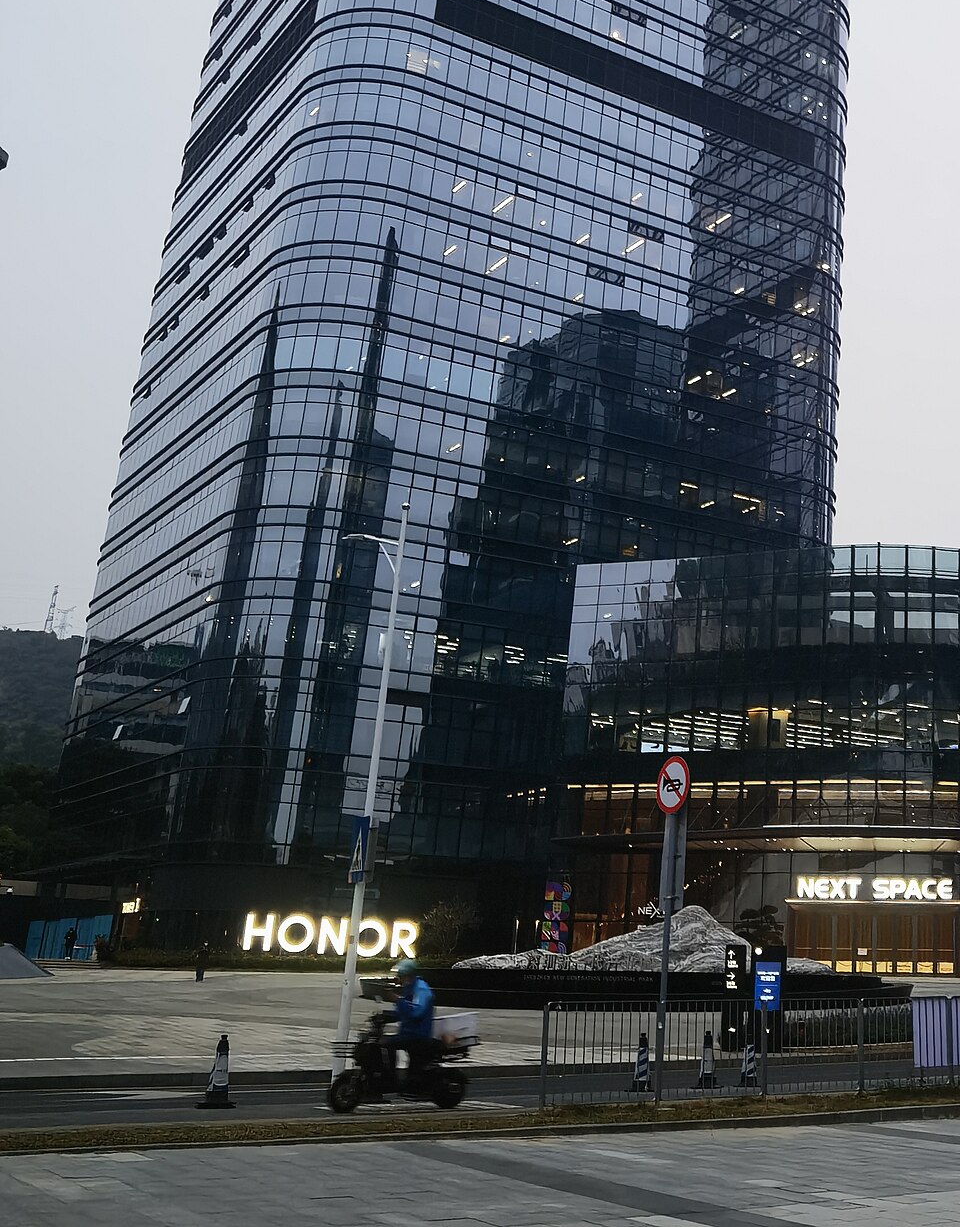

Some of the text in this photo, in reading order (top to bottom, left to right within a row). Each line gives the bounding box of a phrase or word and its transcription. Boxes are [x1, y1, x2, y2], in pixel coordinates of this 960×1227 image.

[797, 877, 953, 900] NEXT SPACE
[242, 913, 416, 959] HONOR
